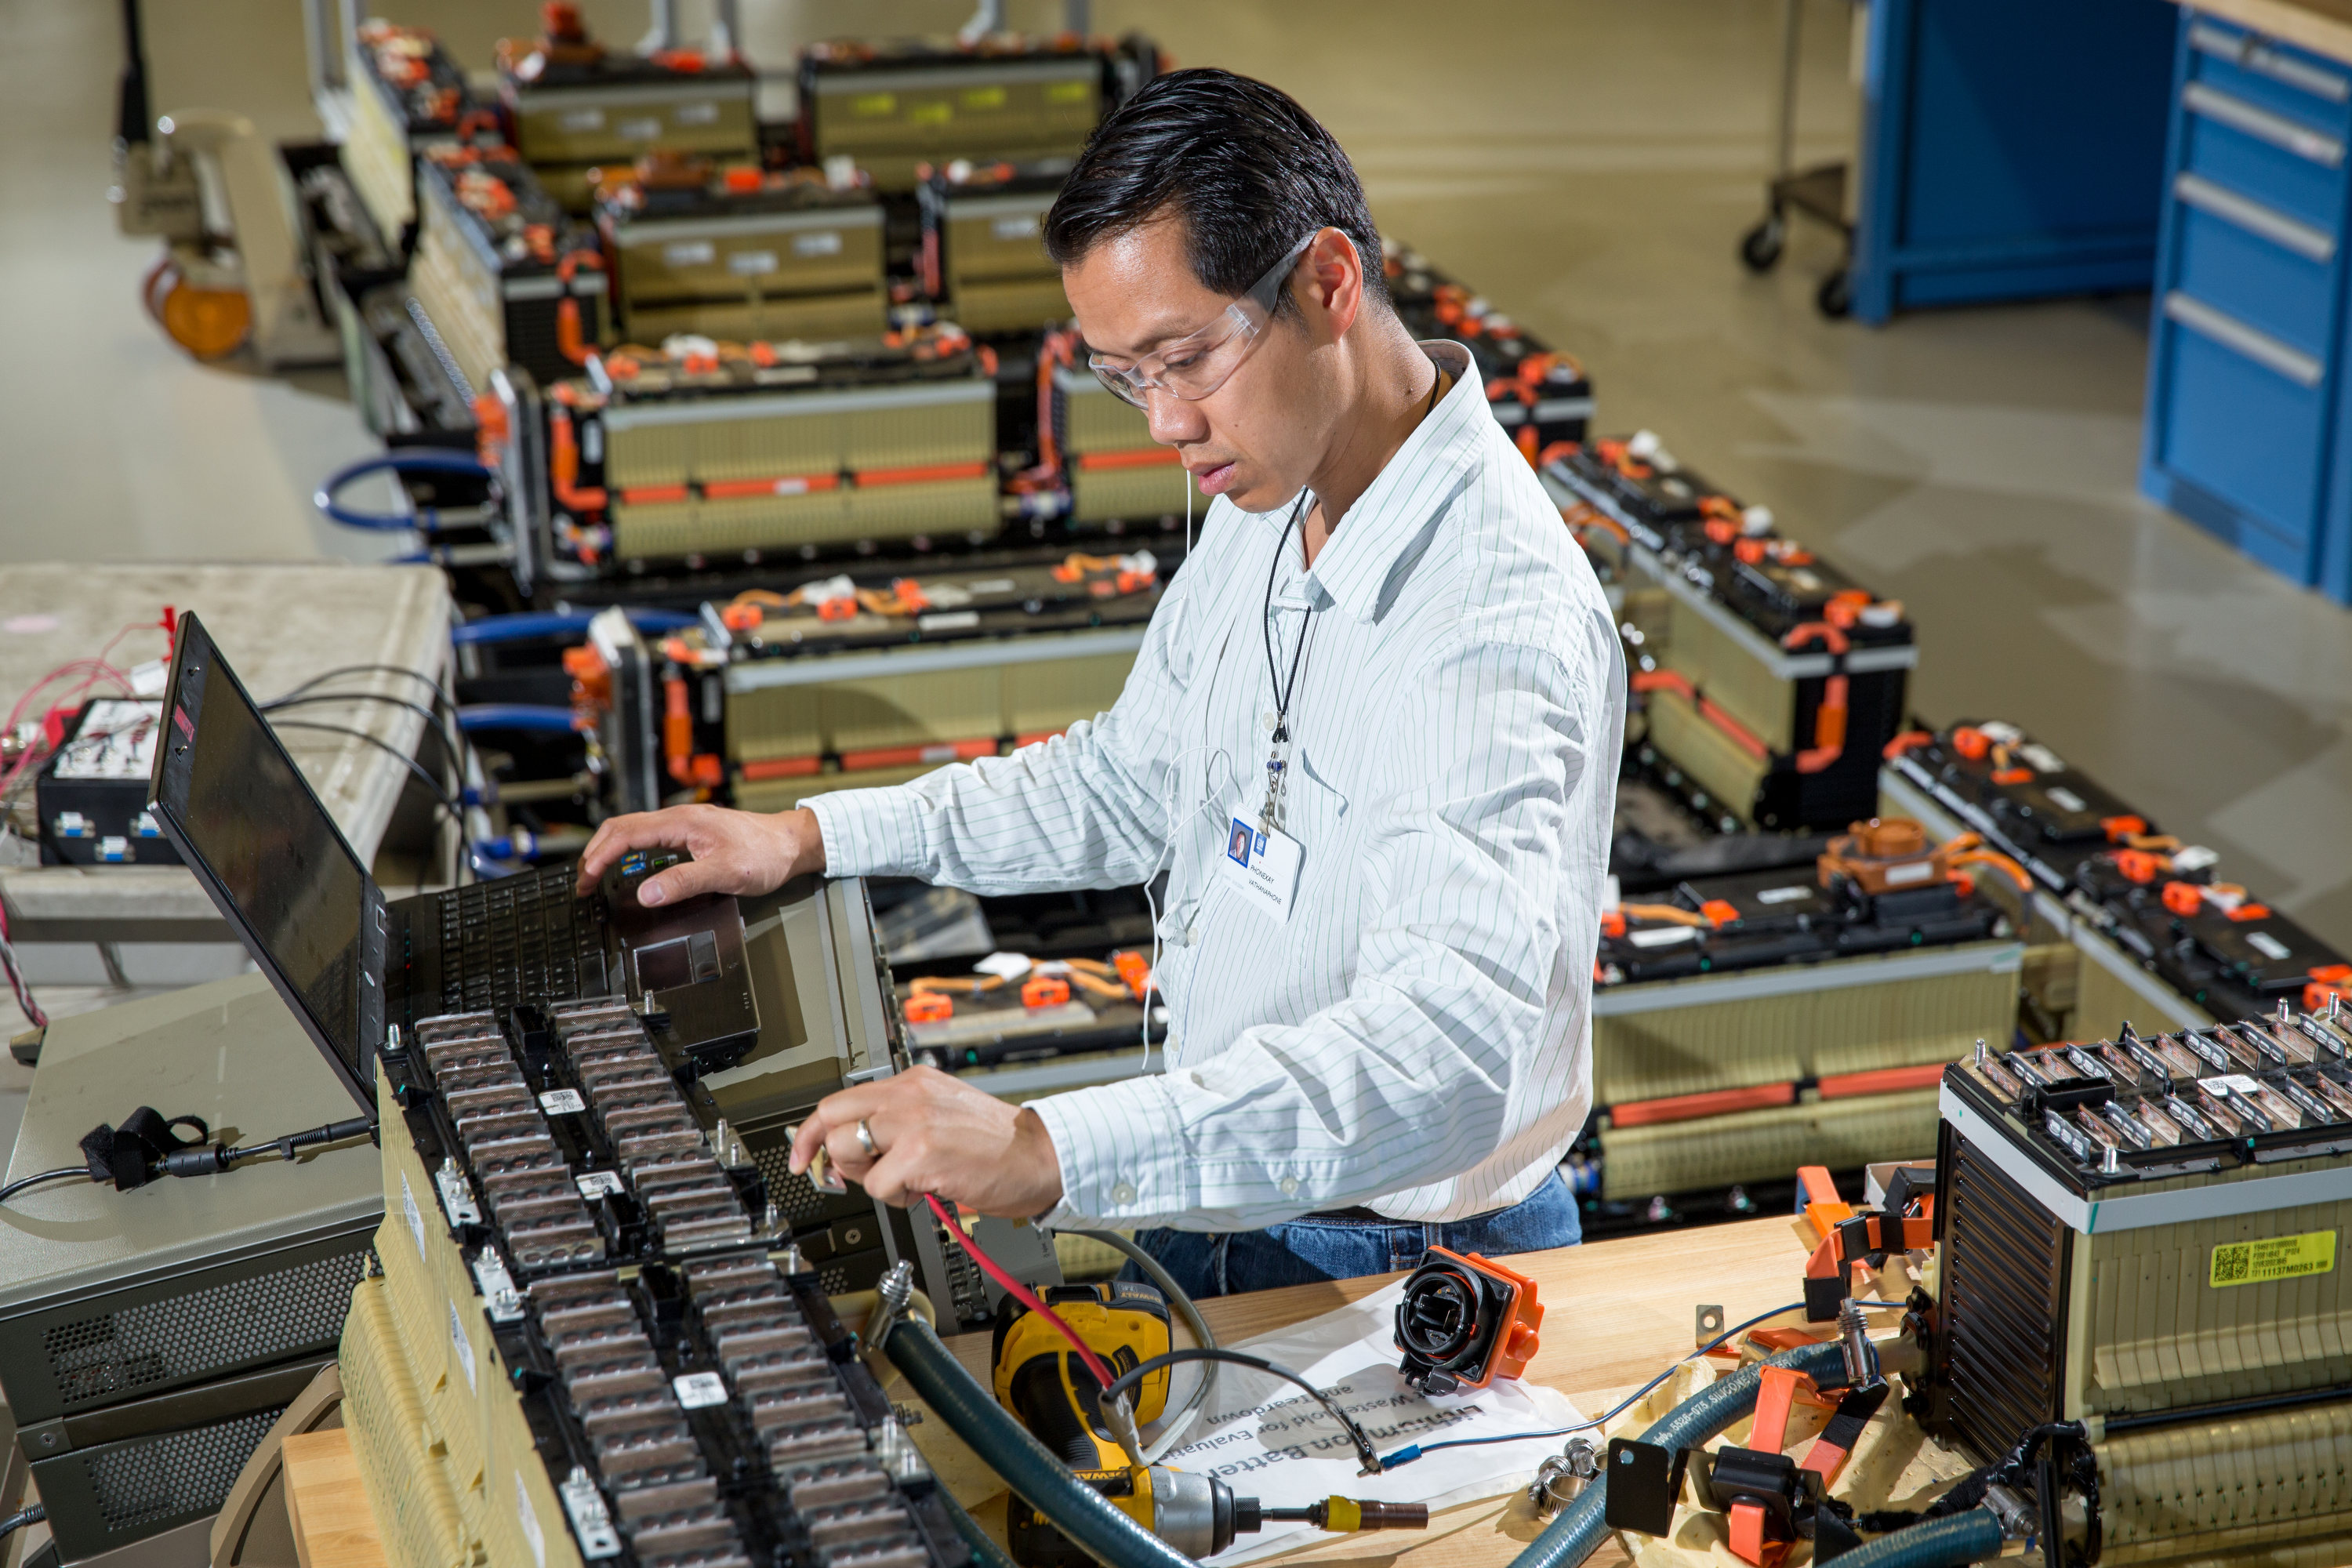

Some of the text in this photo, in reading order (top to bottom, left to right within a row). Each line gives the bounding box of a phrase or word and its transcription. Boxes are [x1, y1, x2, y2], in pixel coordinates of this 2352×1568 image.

[1250, 865, 1275, 884] PHONEXAY
[1248, 878, 1282, 905] VATHANAPHONE
[1345, 1393, 1414, 1414] Waste
[1669, 1401, 1708, 1432] 5526-075
[1708, 1375, 1751, 1404] SILICONE
[1751, 1359, 1793, 1380] HTER
[1206, 1396, 1315, 1425] Teardown
[1292, 1410, 1334, 1428] old
[1258, 1421, 1290, 1435] for
[1198, 1405, 1484, 1479] Lithium on Batter
